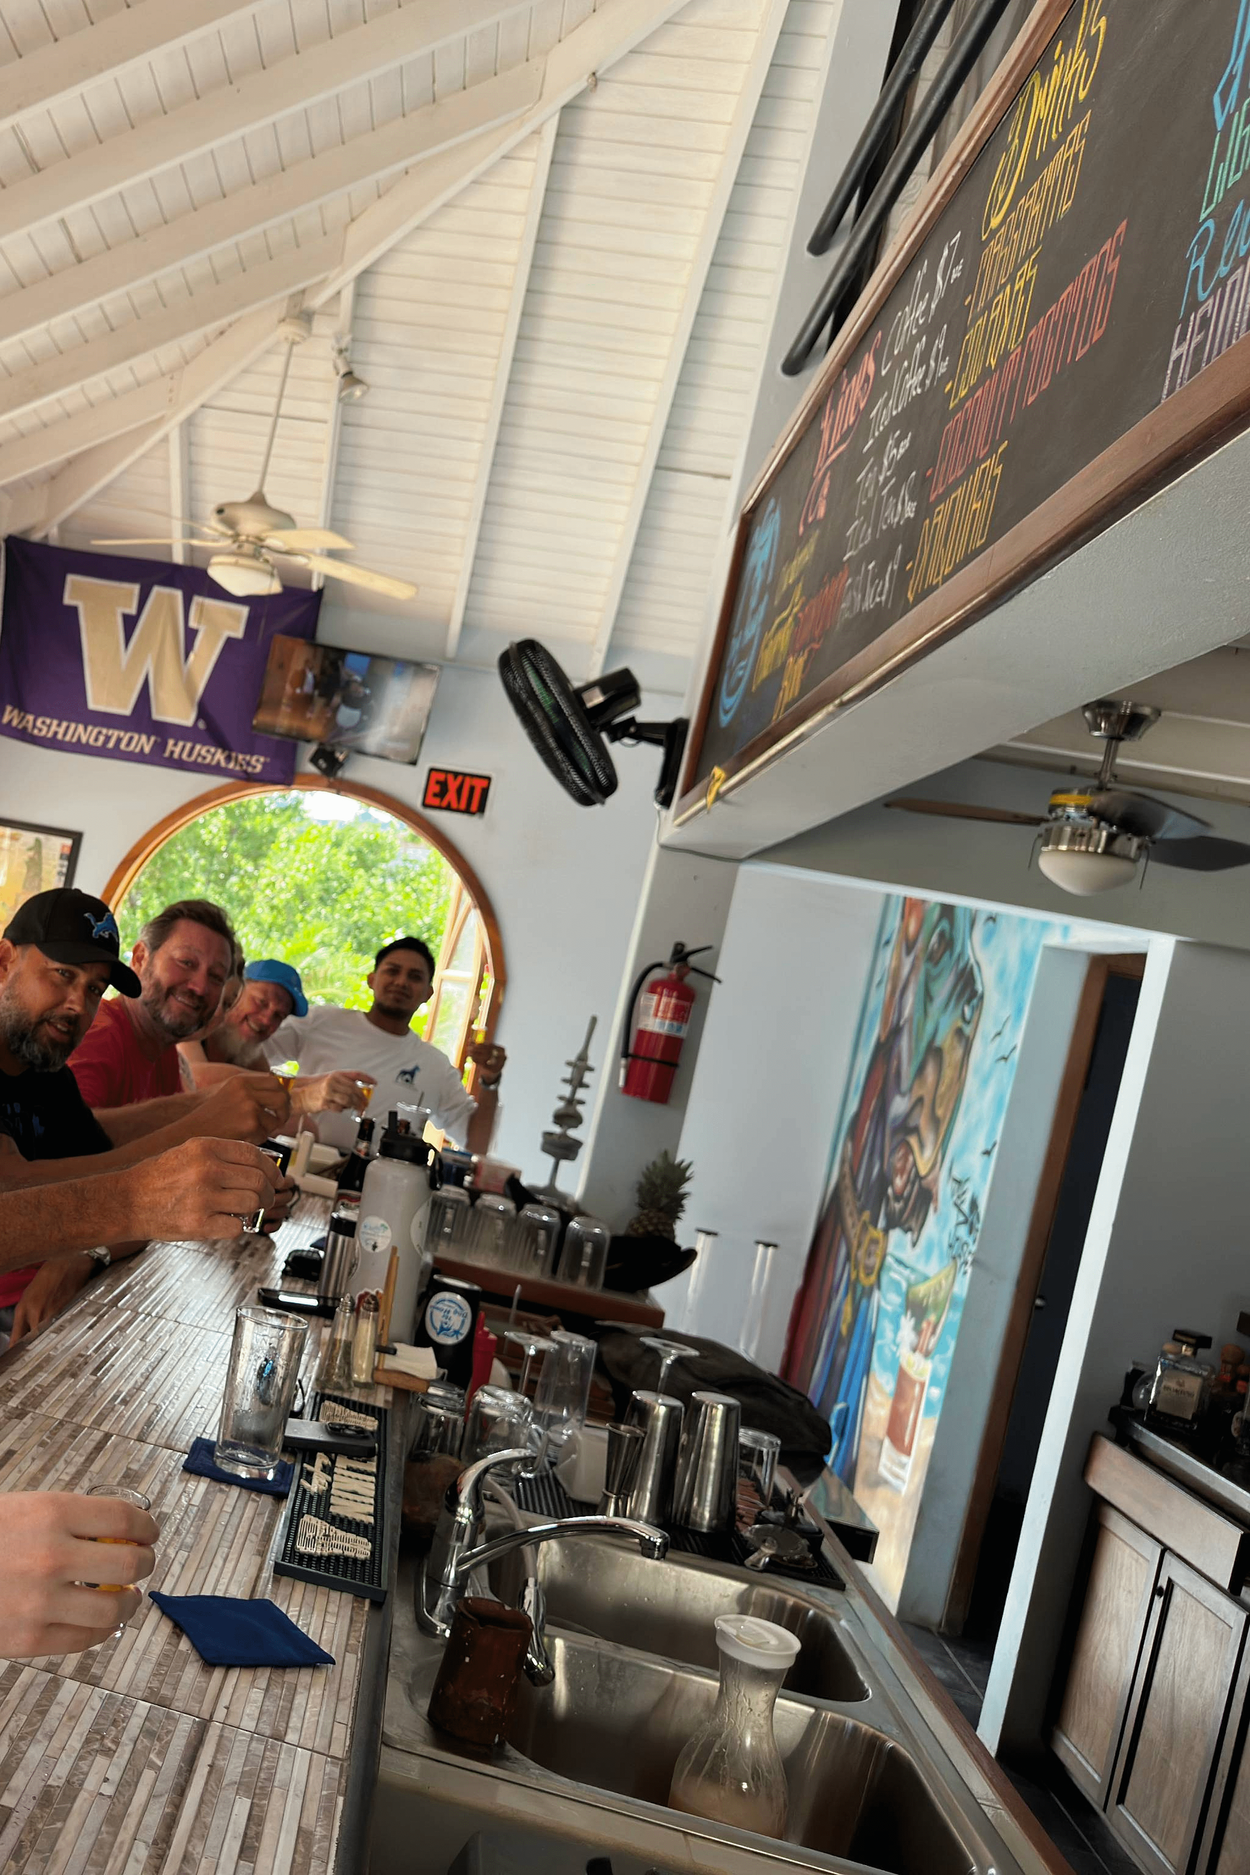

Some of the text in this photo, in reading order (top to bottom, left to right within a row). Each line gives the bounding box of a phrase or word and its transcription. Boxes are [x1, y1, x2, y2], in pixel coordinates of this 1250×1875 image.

[881, 259, 929, 376] Coffee
[63, 573, 250, 727] W
[1, 704, 267, 773] WASHINGTON HUSKIES
[424, 771, 489, 813] EXIT
